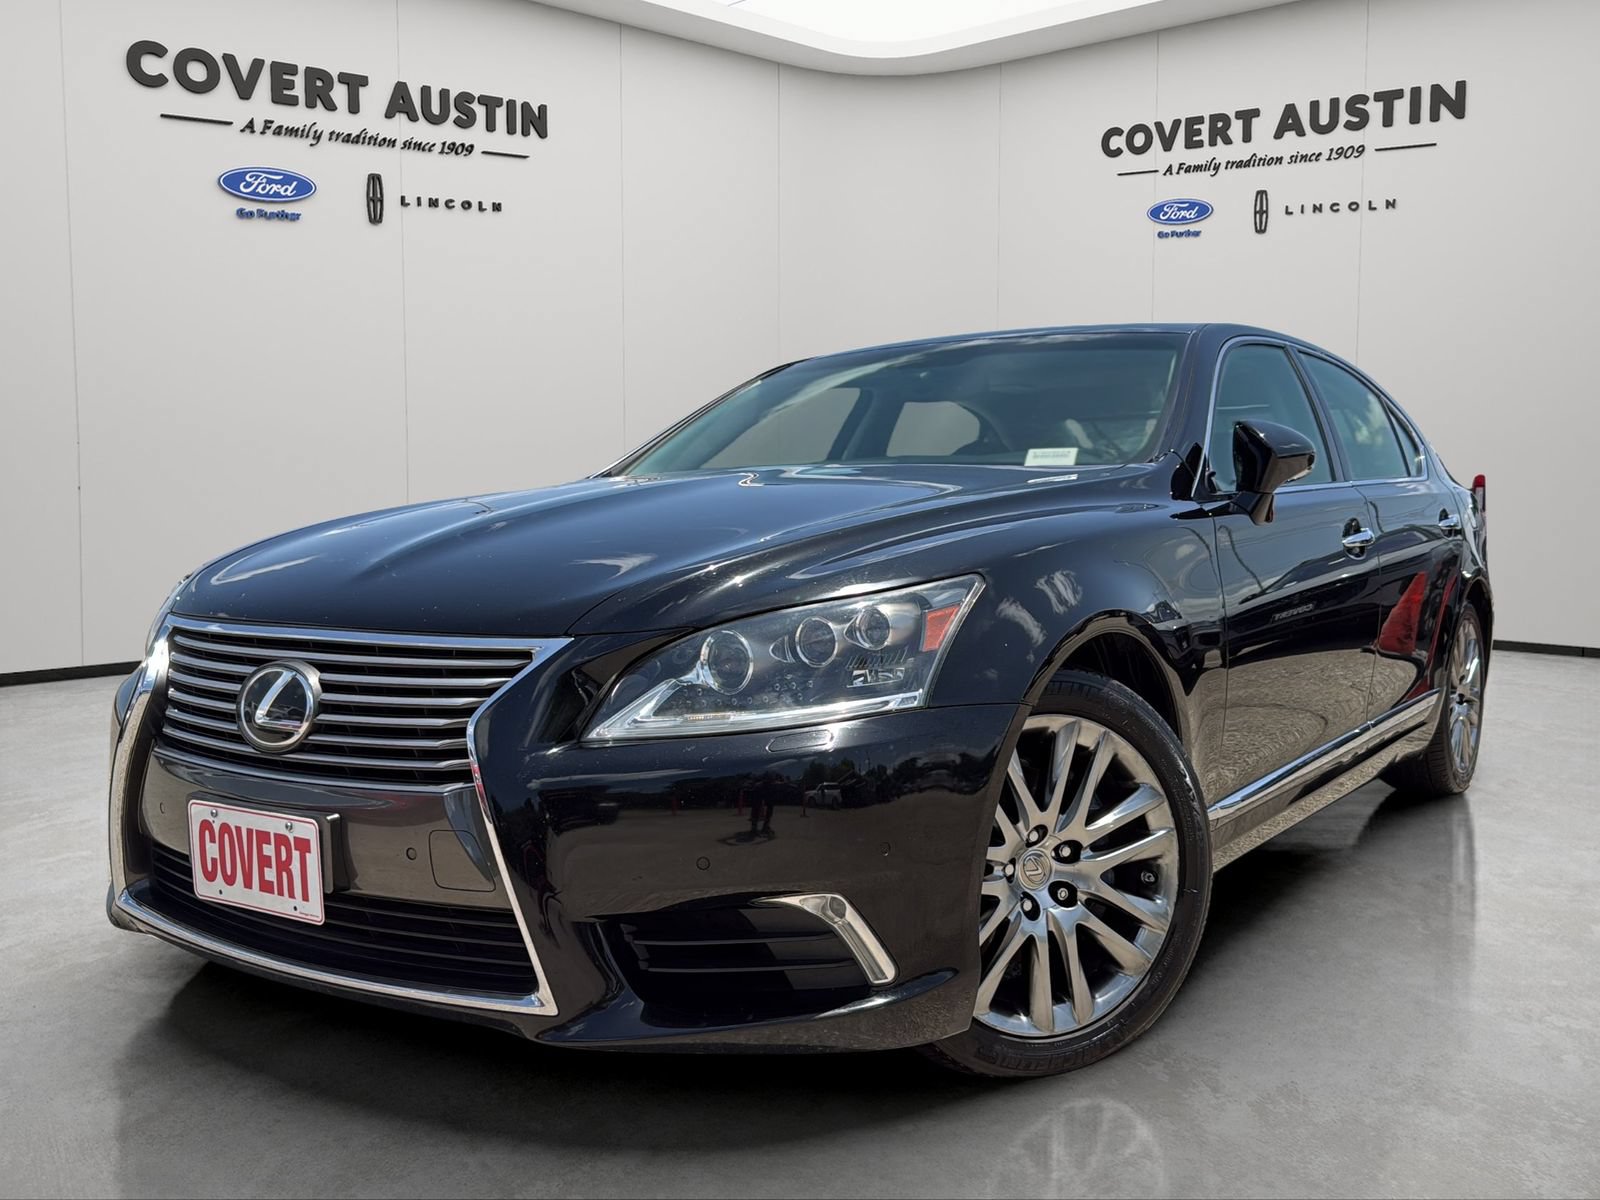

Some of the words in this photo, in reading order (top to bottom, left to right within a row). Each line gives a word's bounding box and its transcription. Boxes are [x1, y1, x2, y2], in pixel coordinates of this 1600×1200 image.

[126, 40, 369, 114] COVERT
[384, 81, 548, 139] AUSTIN
[1101, 107, 1260, 158] COVERT
[1273, 80, 1467, 140] AUSTIN
[240, 117, 255, 134] A
[260, 119, 323, 147] Family
[328, 127, 397, 149] tradition
[400, 136, 436, 153] since
[438, 140, 475, 157] 1909
[1163, 164, 1173, 176] A
[1176, 157, 1221, 177] Family
[1225, 153, 1283, 170] tradition
[1287, 151, 1322, 164] since
[1326, 144, 1365, 161] 1909
[240, 172, 298, 196] Ford
[400, 195, 502, 213] LINCOLN
[1160, 203, 1199, 220] Ford
[1285, 198, 1397, 216] LINCOLN
[199, 819, 311, 902] COVERT
